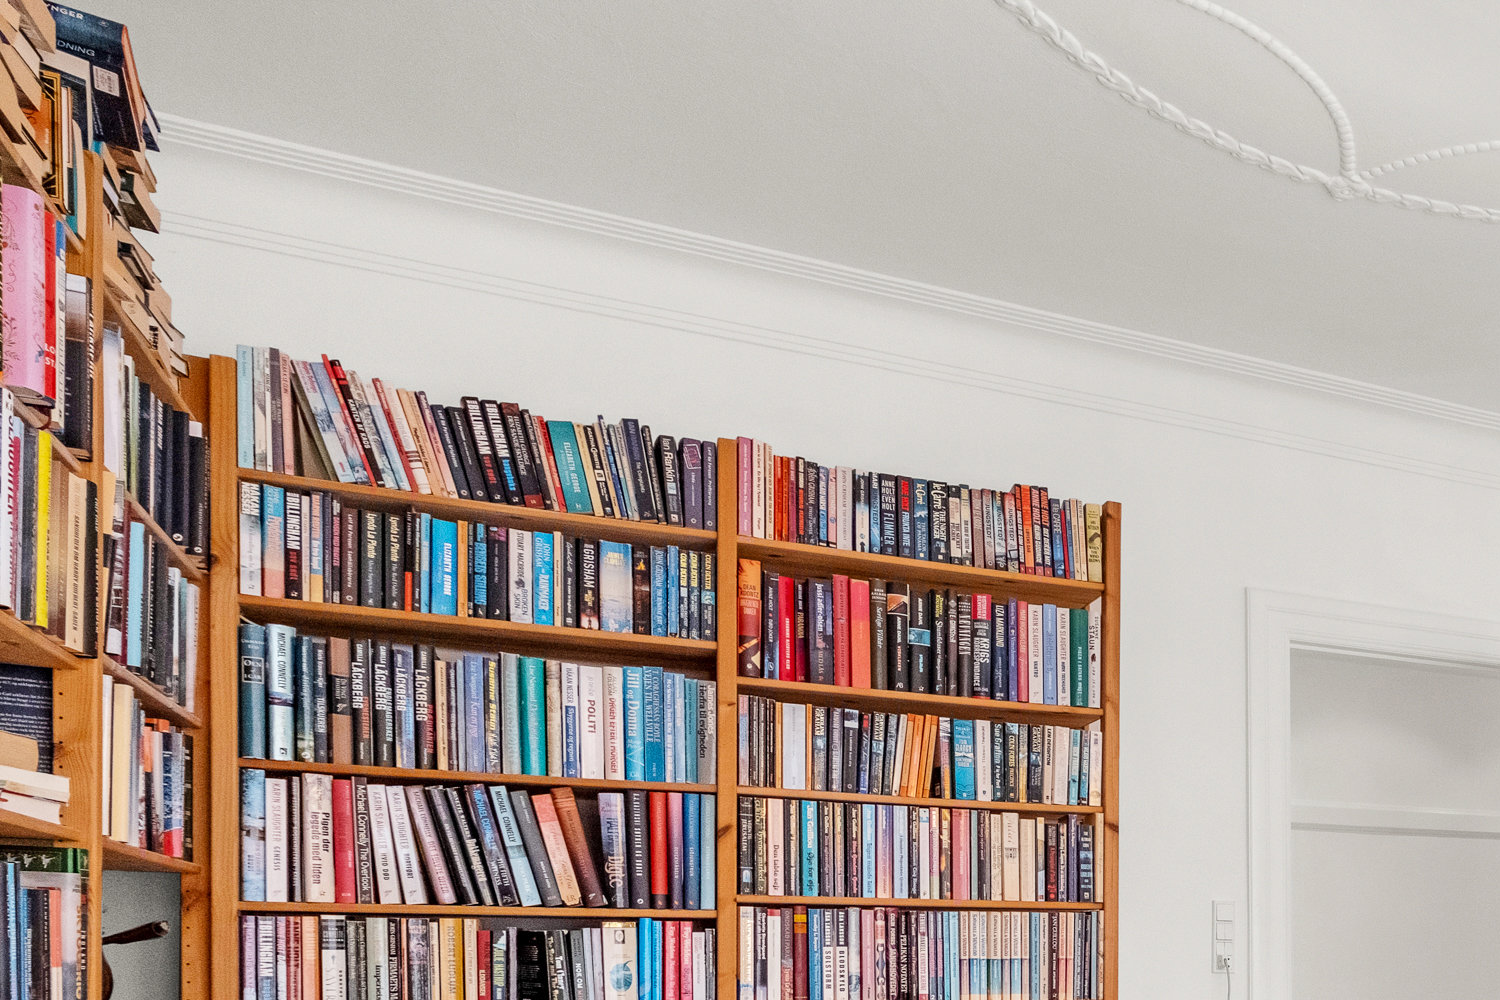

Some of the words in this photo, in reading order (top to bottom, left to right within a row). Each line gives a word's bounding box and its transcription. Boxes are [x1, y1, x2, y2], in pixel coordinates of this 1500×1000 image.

[46, 3, 85, 20] NGER
[56, 39, 96, 57] DNING
[471, 404, 494, 454] BILLINGHAM
[513, 416, 524, 442] ELIZABETH
[520, 443, 530, 465] GEORGE
[662, 438, 673, 450] Ian
[663, 451, 675, 482] Rankin
[931, 491, 945, 510] Carré
[287, 496, 300, 550] BILLINGHAM
[366, 514, 377, 529] Lynda
[389, 517, 400, 532] Lynda
[884, 512, 895, 545] FLIMMER
[901, 512, 909, 533] FRUKTA
[367, 538, 376, 558] Plante
[390, 541, 399, 561] Plante
[516, 533, 524, 551] STUART
[443, 543, 452, 572] ELIZABETH
[517, 552, 525, 579] MACBRIDE
[584, 549, 597, 588] GRISHAM
[443, 575, 452, 595] GEORGE
[534, 537, 543, 567] GRISHAM
[539, 574, 549, 610] RAINMAKER
[995, 605, 1004, 617] LIZA
[278, 632, 287, 658] MICHAEL
[996, 618, 1004, 647] MARKLUND
[1088, 626, 1096, 650] STAUN
[973, 637, 981, 686] KORRESPONDANCE
[980, 638, 990, 663] KRIGS
[278, 661, 287, 690] CONNELLY
[352, 663, 365, 708] LÄCKBERG
[488, 661, 497, 701] Susanne
[627, 670, 642, 688] Jill
[626, 690, 636, 699] og
[698, 685, 706, 708] Herfra
[707, 685, 715, 710] James
[316, 698, 325, 732] TILSKUEREN
[489, 703, 497, 730] Staun
[566, 708, 576, 734] Skyggerne
[587, 699, 596, 734] POLITI
[627, 701, 640, 737] Donna
[707, 711, 715, 734] Jones
[698, 720, 706, 759] evigheden
[272, 783, 281, 800] KARIN
[357, 785, 368, 813] Michael
[273, 803, 282, 842] SLAUGHTER
[321, 813, 330, 836] Pigen
[357, 815, 369, 846] Connelly
[495, 791, 507, 815] MICHAEL
[501, 816, 516, 843] CONNELLY
[273, 846, 281, 871] GENESIS
[359, 848, 369, 860] The
[361, 861, 370, 891] Overlook
[259, 925, 273, 976] BILLINGHAM
[375, 965, 383, 1000] imperiets
[390, 957, 399, 992] FIRMAETS
